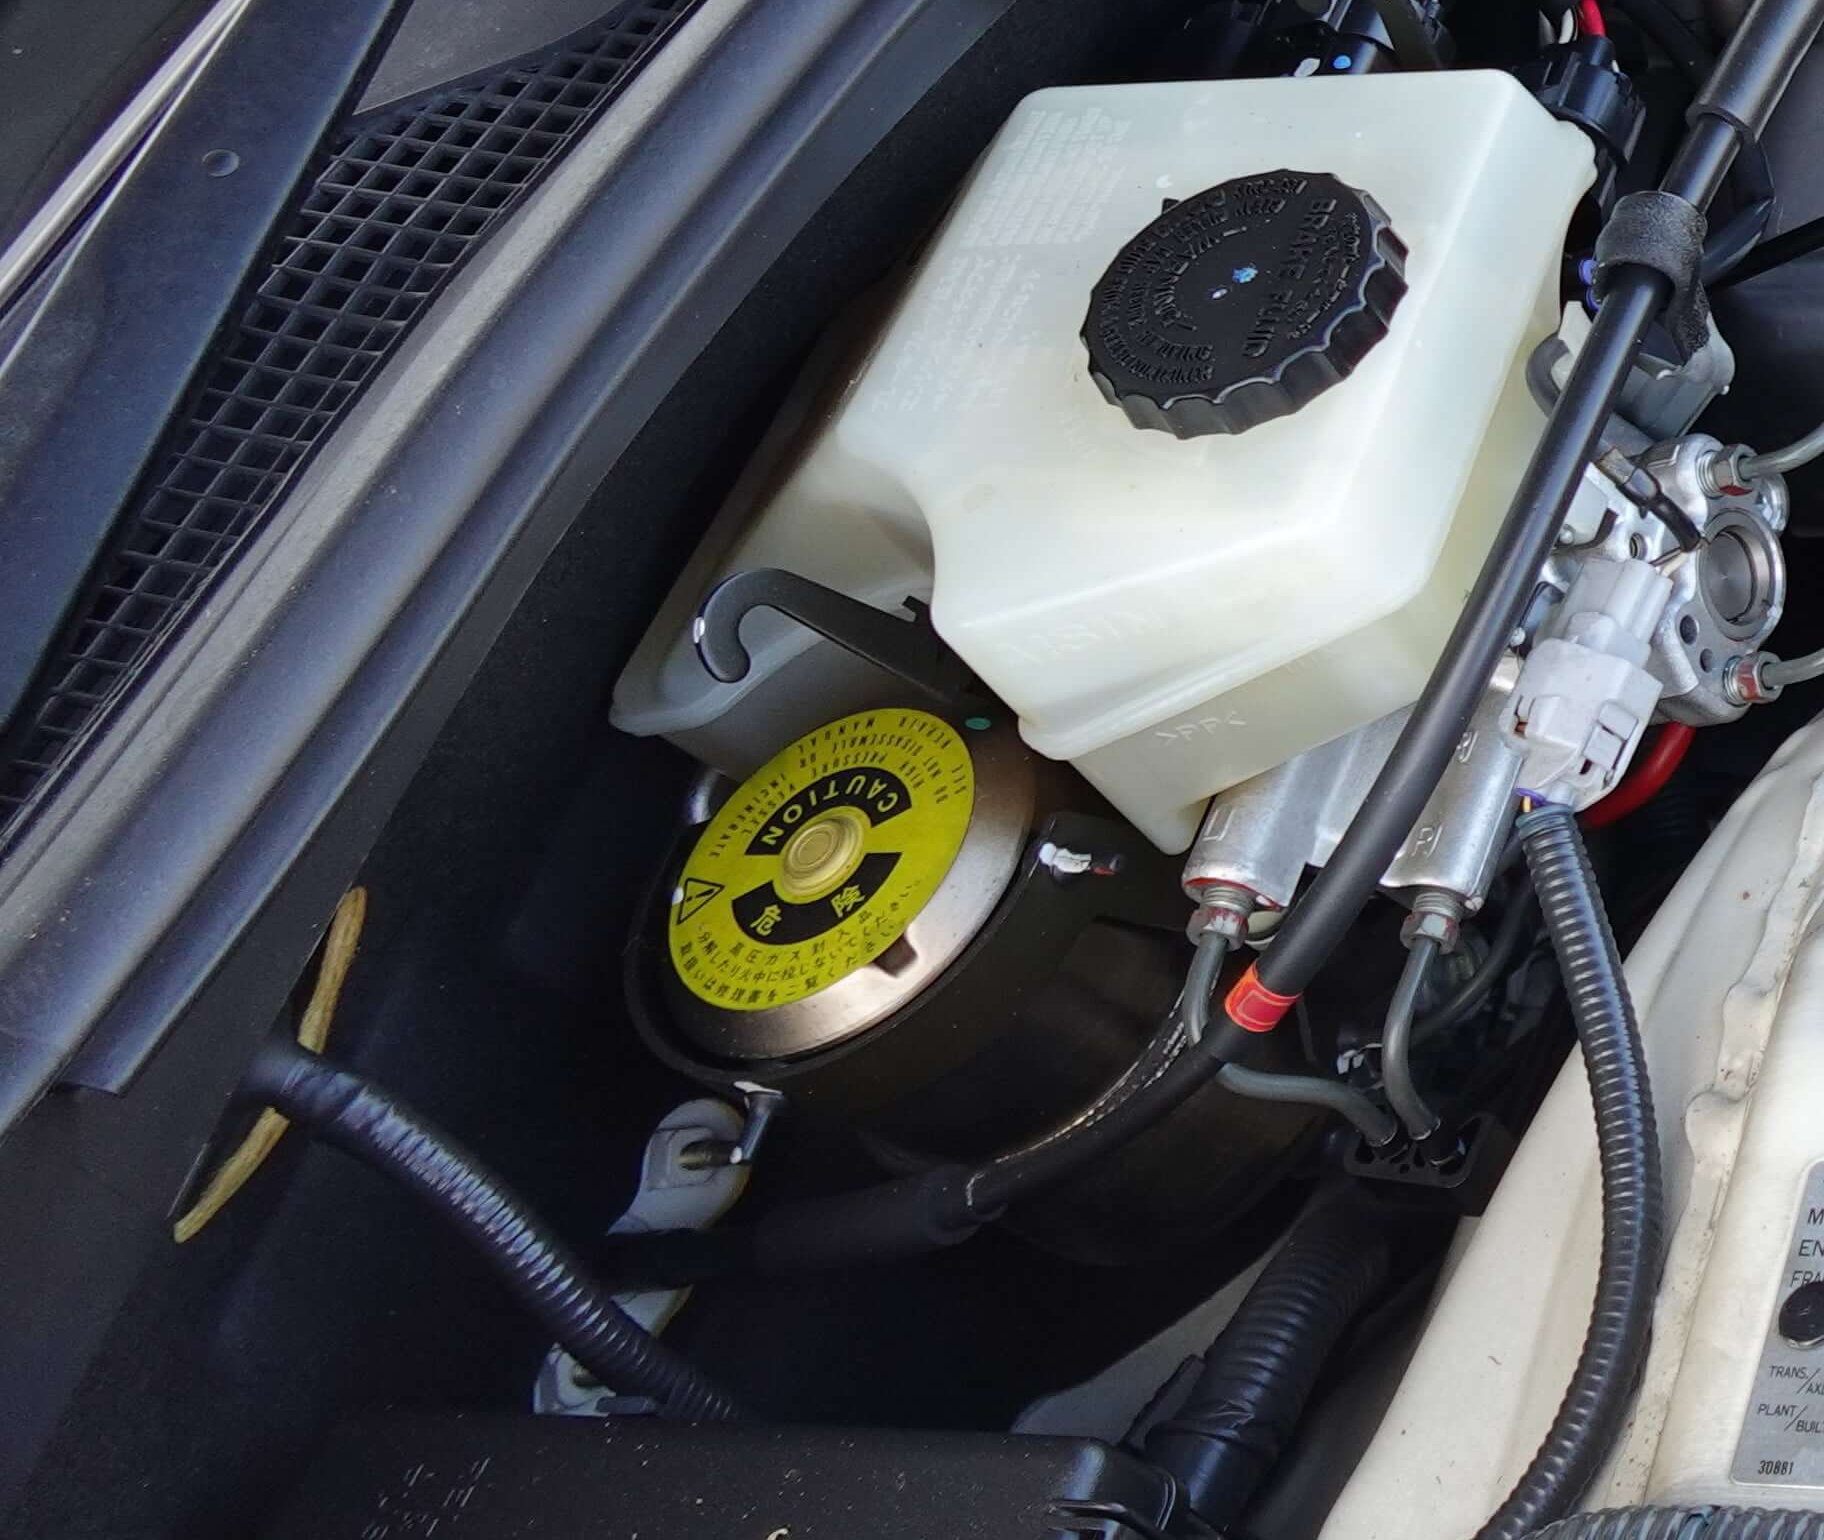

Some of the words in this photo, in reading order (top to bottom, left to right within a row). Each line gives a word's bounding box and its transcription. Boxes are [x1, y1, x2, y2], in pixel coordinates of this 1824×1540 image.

[1276, 199, 1337, 280] BRAKE
[1243, 290, 1294, 357] FLUID
[763, 774, 899, 847] CAUTION
[750, 884, 866, 937] 危険
